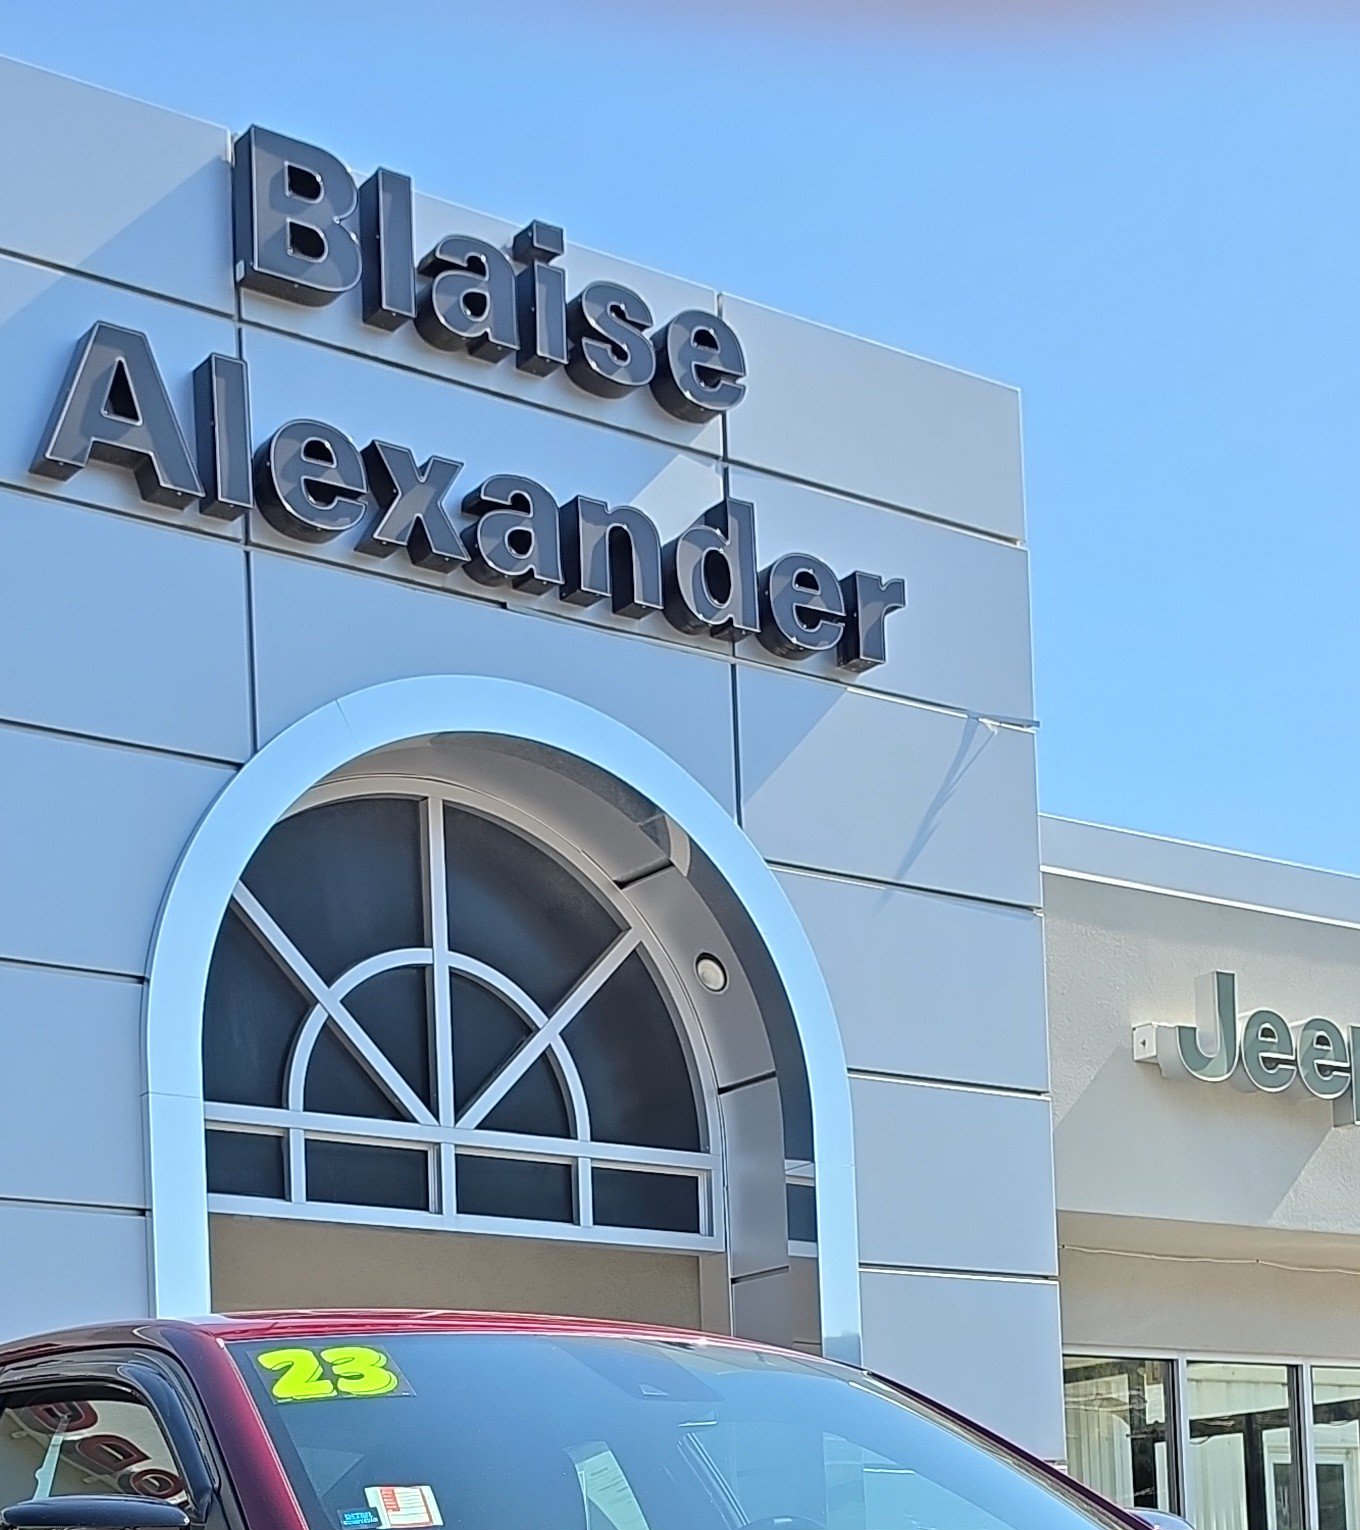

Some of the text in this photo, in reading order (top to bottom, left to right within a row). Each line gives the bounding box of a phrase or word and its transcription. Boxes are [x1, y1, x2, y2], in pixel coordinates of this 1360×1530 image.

[233, 125, 748, 423] Blaise
[29, 321, 906, 674] Alexander
[257, 1346, 399, 1403] 23
